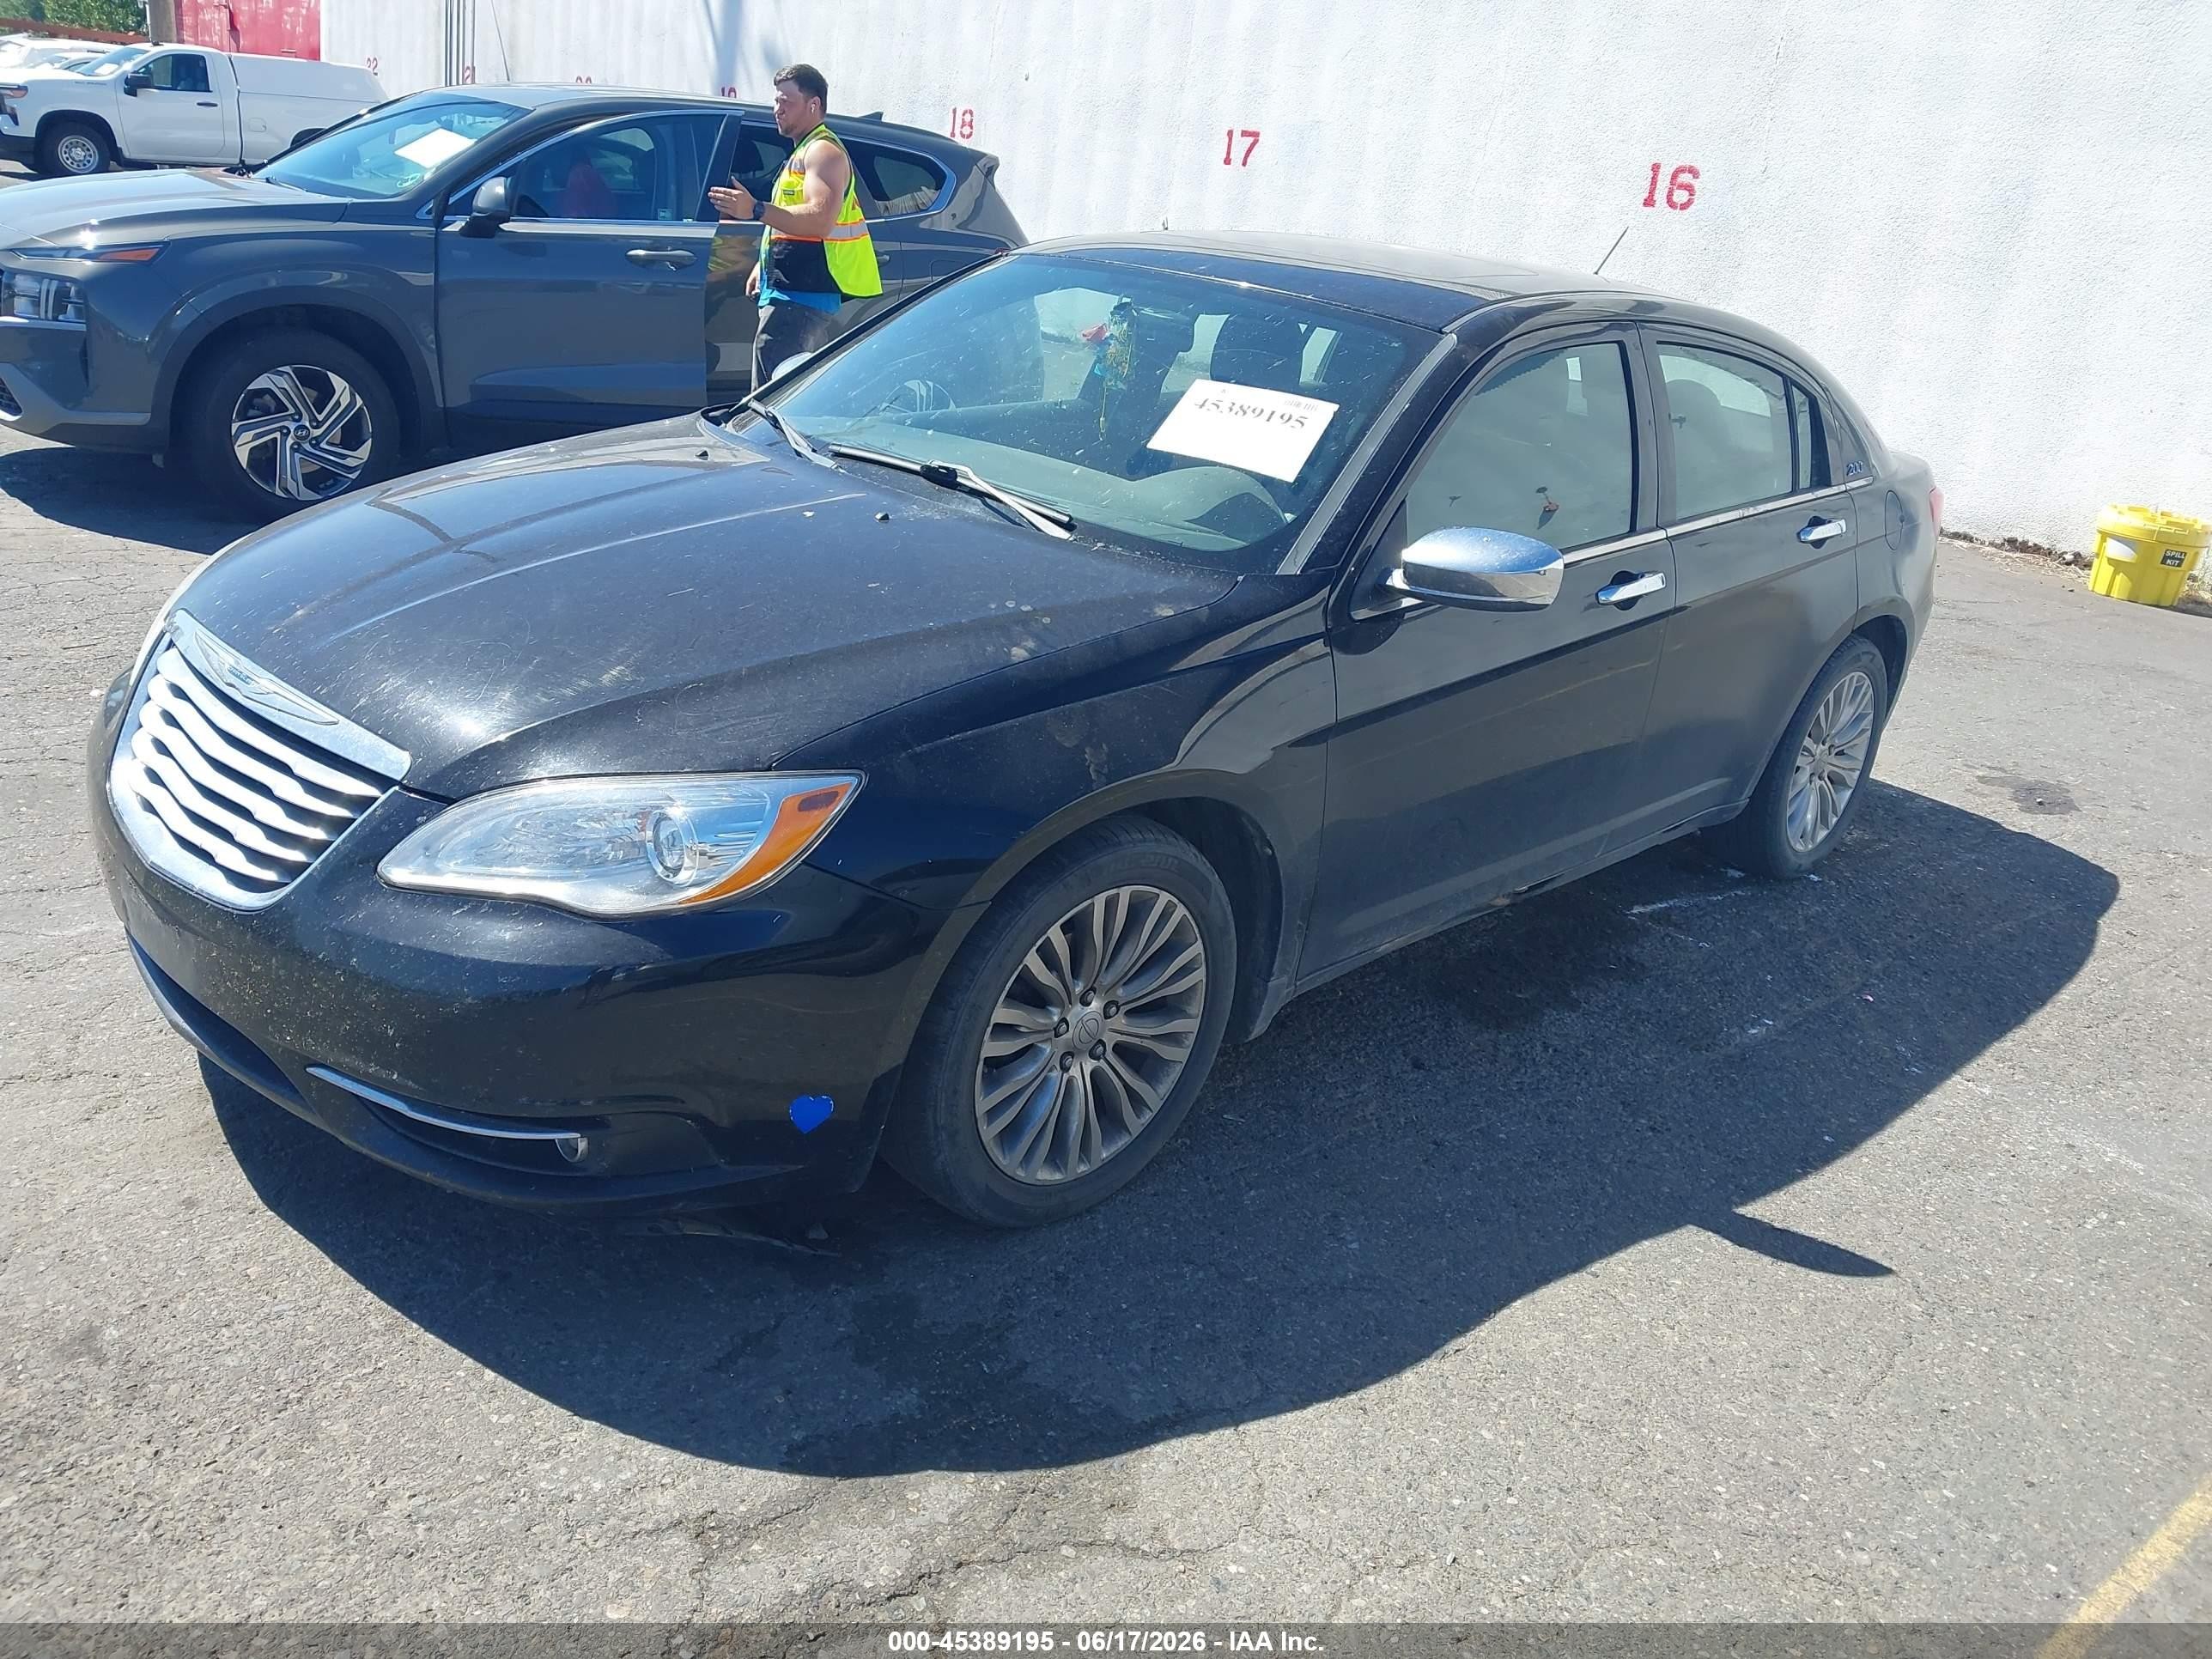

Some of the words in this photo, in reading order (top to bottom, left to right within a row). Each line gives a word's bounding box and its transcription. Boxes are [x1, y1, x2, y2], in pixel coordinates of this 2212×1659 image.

[950, 106, 974, 139] 18
[1224, 129, 1261, 167] 17
[1643, 162, 1700, 211] 16
[1194, 397, 1310, 430] 45389195
[2165, 550, 2186, 559] SPILL
[2166, 558, 2180, 567] KIT
